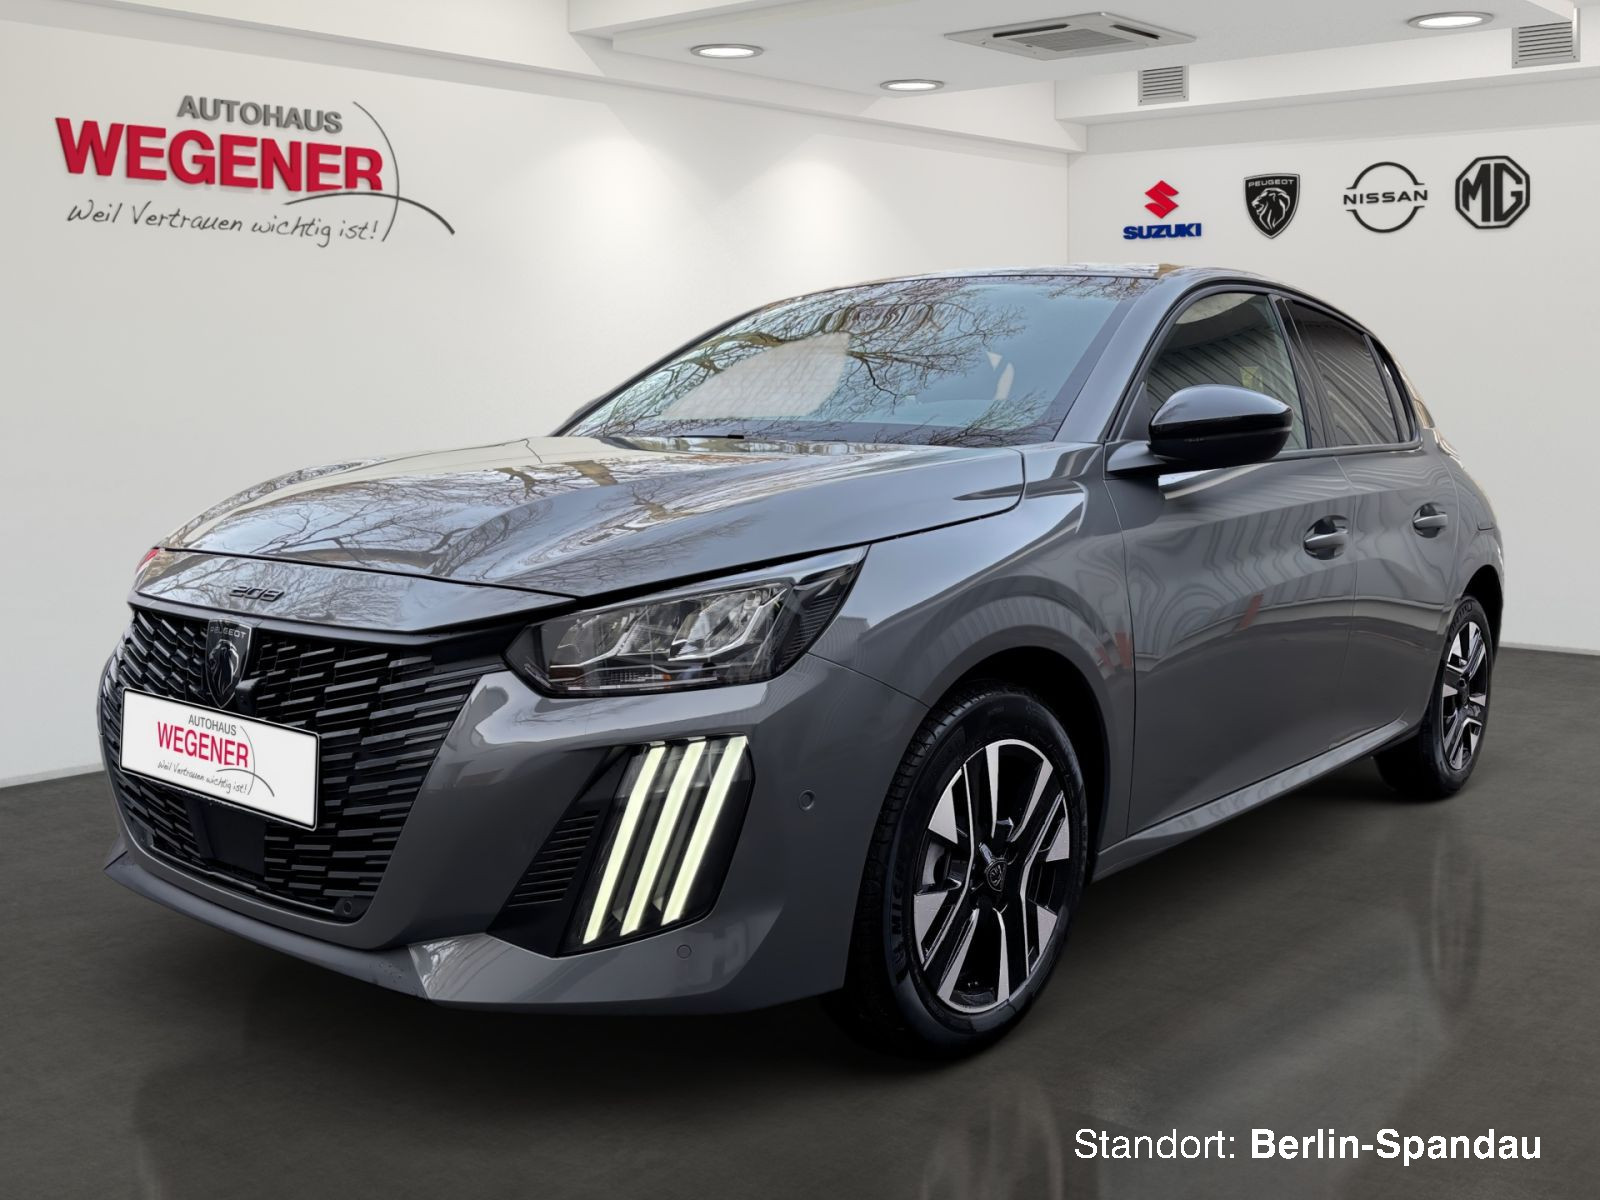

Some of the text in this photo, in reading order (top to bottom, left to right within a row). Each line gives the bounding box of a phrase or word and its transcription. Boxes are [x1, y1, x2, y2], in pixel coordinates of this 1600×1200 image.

[176, 95, 343, 134] AUTOHAUS
[55, 117, 384, 193] WEGENER
[1248, 179, 1295, 188] PEUGEOT
[1343, 189, 1428, 206] NISSAN
[1462, 162, 1524, 224] MG
[67, 199, 380, 248] Weil Vertrauen wichtig ist!
[1123, 223, 1202, 240] SUZUKI
[157, 721, 249, 768] WEGENER
[188, 714, 237, 736] AUTOHAUS
